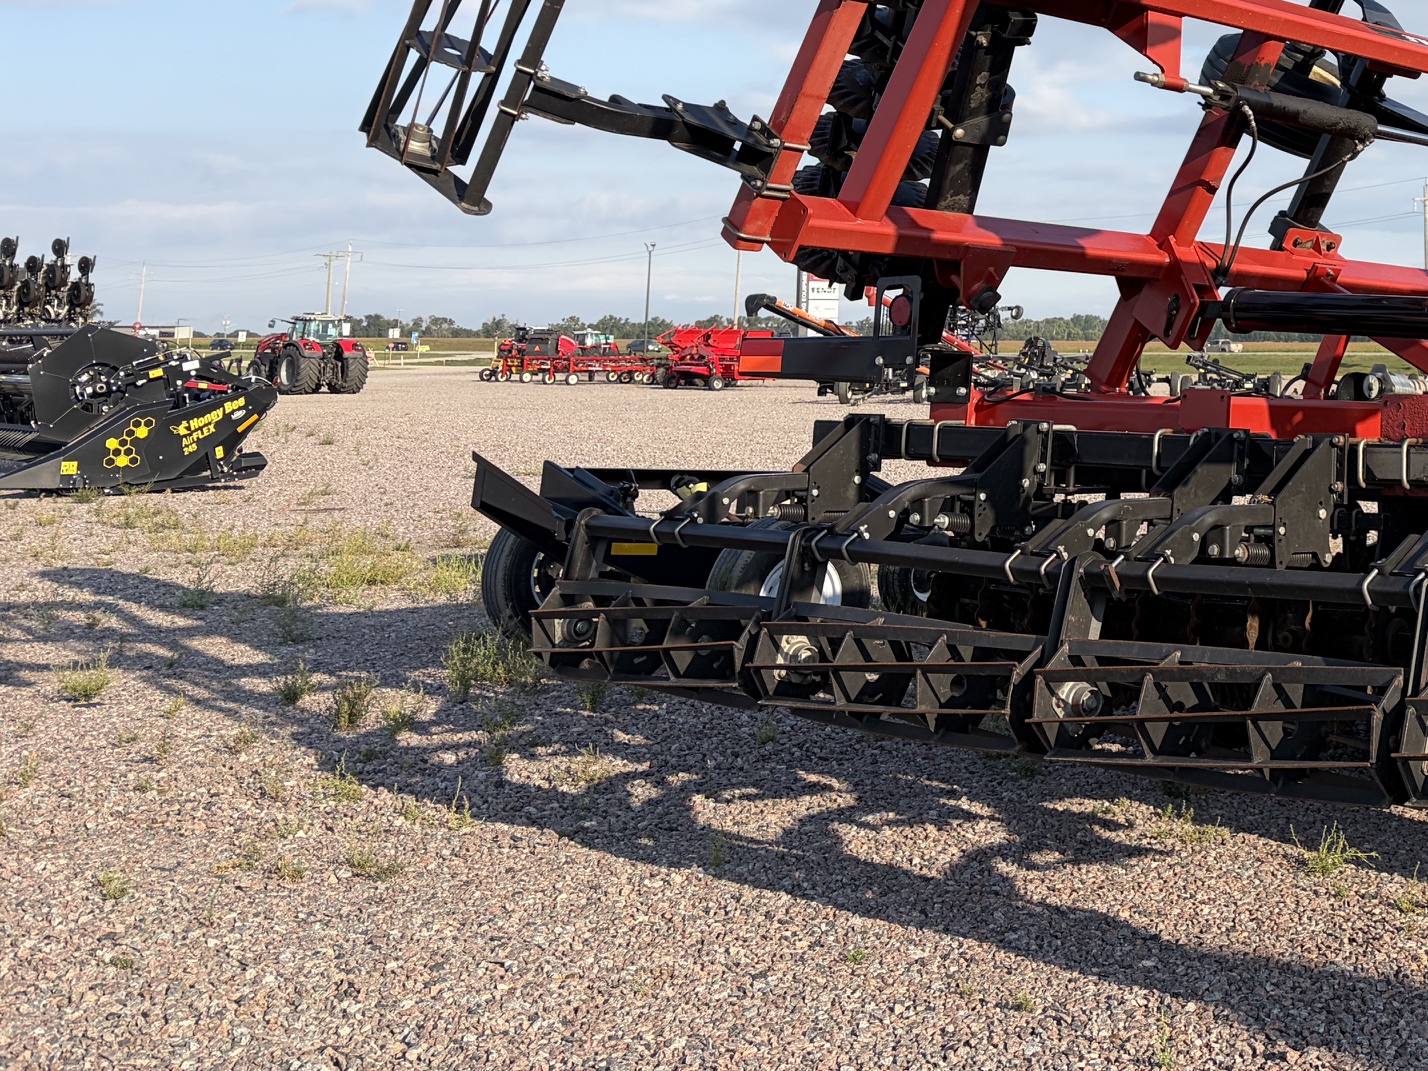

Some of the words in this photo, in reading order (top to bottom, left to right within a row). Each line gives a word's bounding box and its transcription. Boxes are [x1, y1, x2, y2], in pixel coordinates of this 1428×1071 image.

[189, 407, 224, 431] Honey
[224, 396, 245, 414] Bee
[182, 423, 216, 447] AirFLEX
[183, 443, 198, 456] 245
